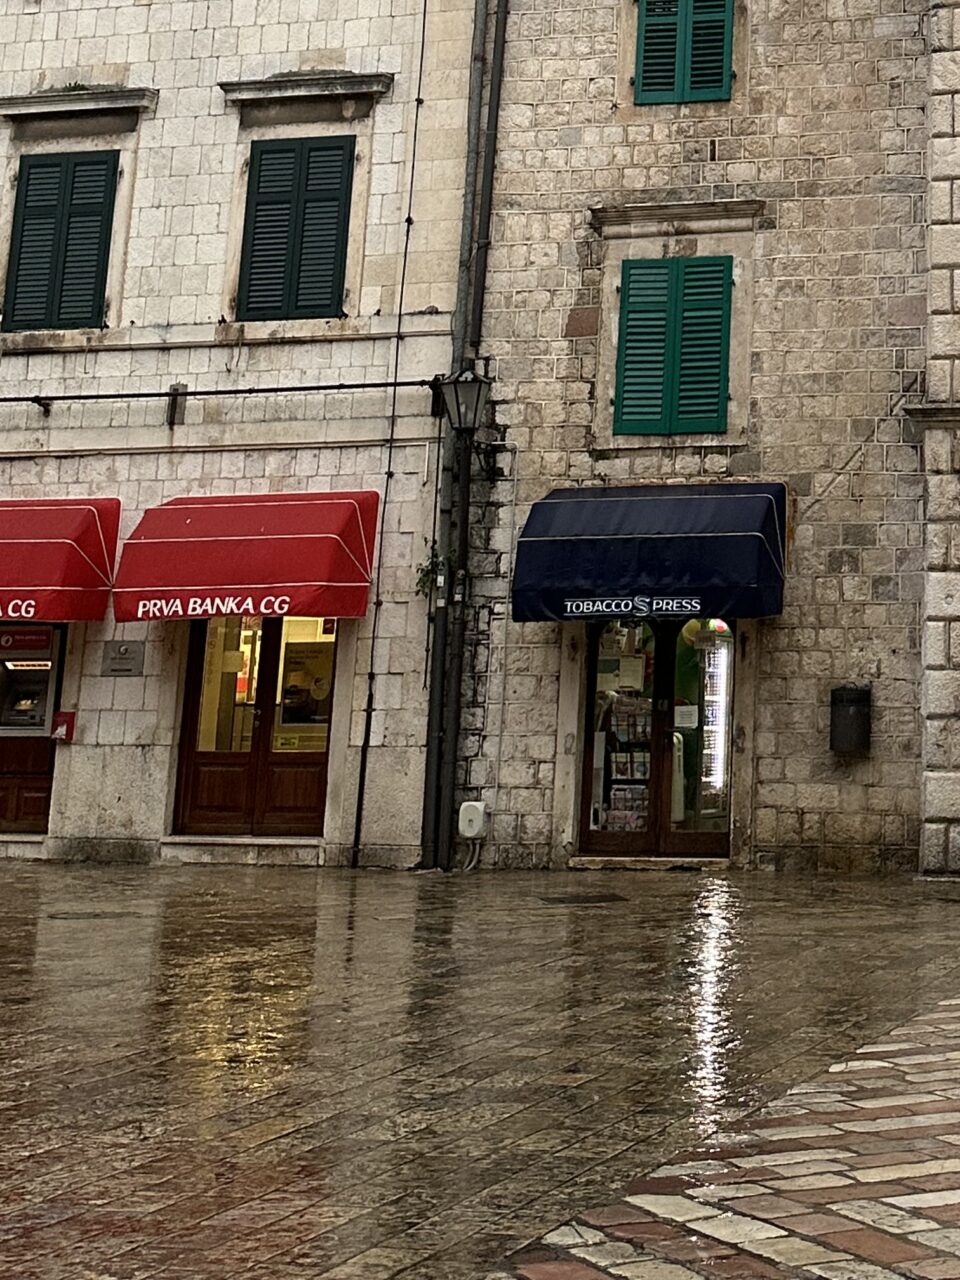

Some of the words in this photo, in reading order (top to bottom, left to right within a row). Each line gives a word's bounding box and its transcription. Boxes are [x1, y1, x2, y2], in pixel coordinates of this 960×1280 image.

[7, 599, 36, 618] CG
[137, 598, 183, 618] PRVA
[187, 596, 255, 615] BANKA
[259, 596, 290, 614] CG
[564, 600, 633, 613] TOBACCO
[652, 599, 701, 611] PRESS
